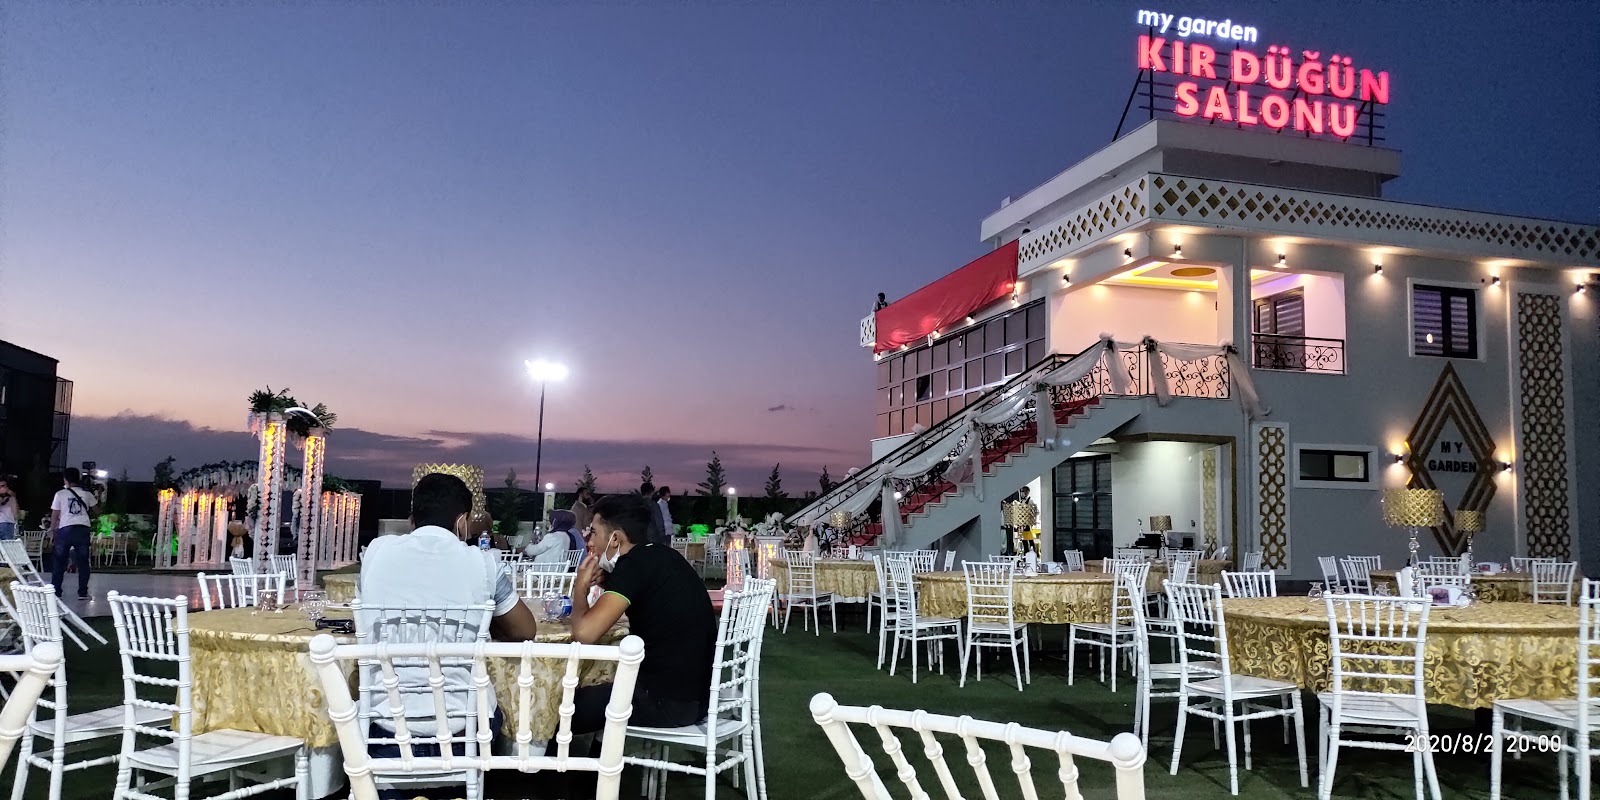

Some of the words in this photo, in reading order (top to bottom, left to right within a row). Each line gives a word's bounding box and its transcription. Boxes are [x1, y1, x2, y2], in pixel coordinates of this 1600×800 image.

[1137, 9, 1173, 33] my
[1177, 16, 1258, 42] garden
[1138, 34, 1217, 80] KIR
[1231, 44, 1389, 104] DÜĞÜN
[1174, 81, 1357, 137] SALONU
[1428, 460, 1477, 473] GARDEN
